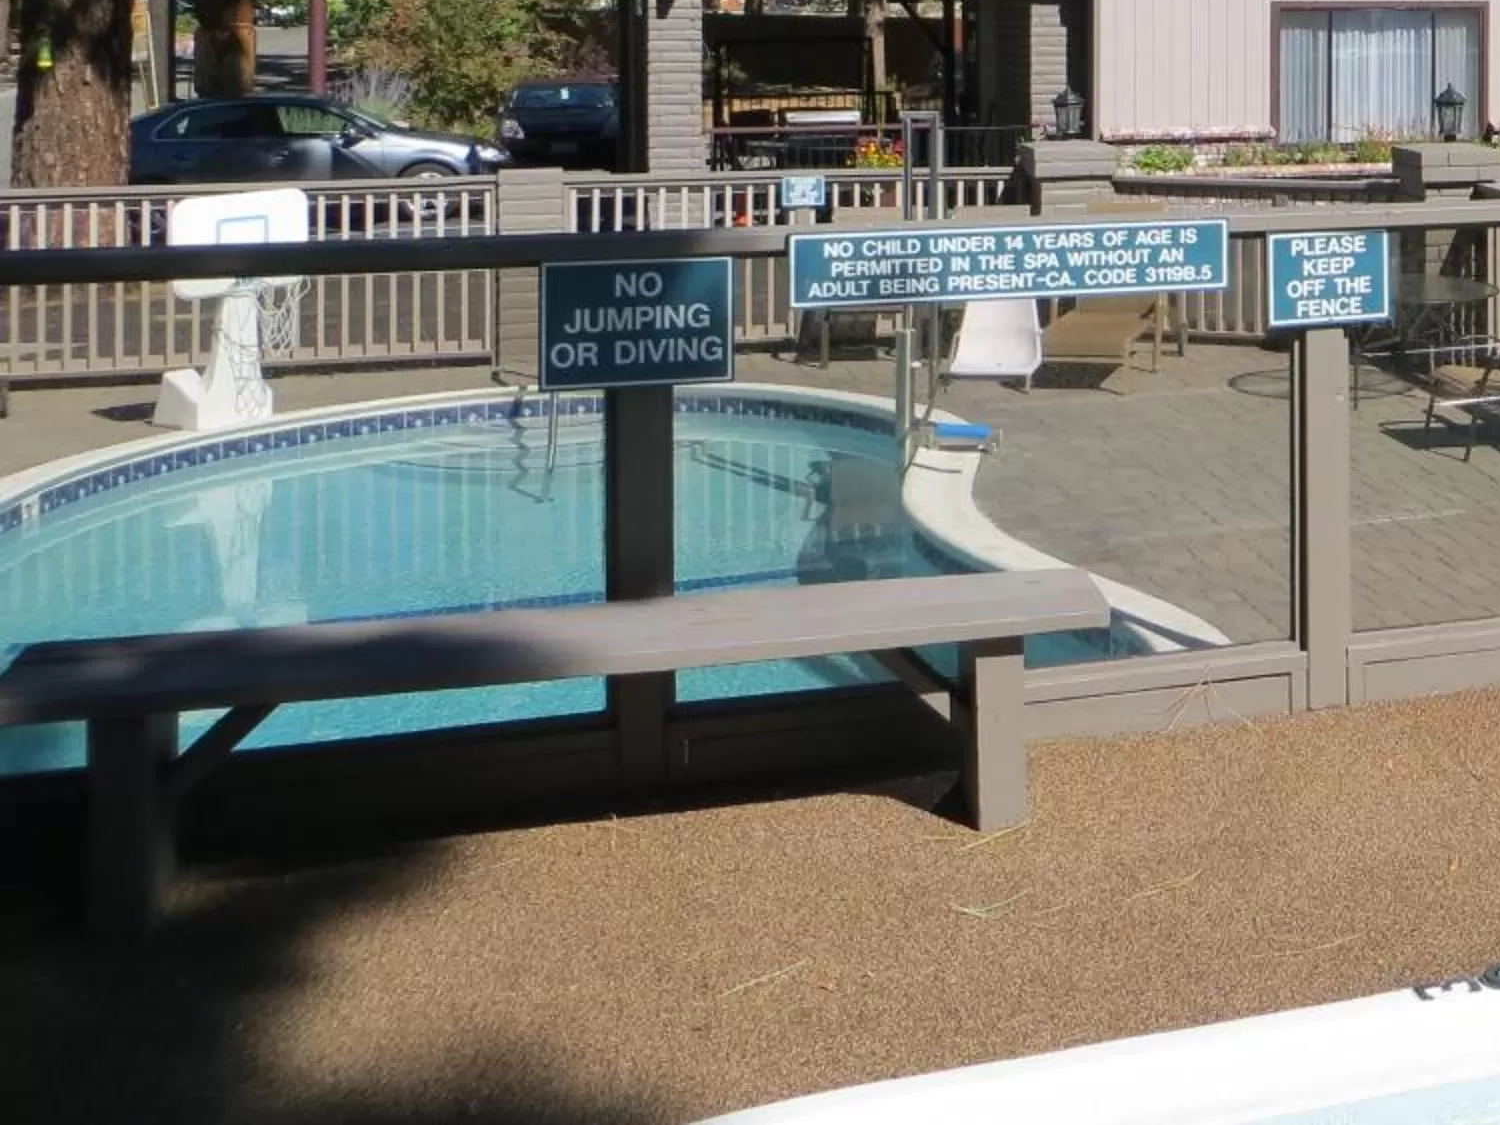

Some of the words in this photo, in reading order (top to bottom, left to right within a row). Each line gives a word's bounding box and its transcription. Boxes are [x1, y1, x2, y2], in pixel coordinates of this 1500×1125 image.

[823, 240, 854, 258] NO
[862, 238, 921, 256] CHILD
[929, 235, 996, 254] UNDER
[1004, 235, 1024, 251] 14
[1033, 232, 1095, 249] YEARS
[1102, 230, 1128, 246] OF
[1135, 228, 1173, 245] AGE
[1180, 227, 1198, 244] IS
[1291, 235, 1367, 257] PLEASE
[831, 259, 943, 277] PERMITTED
[951, 255, 971, 272] IN
[977, 254, 1015, 270] THE
[1023, 253, 1059, 269] SPA
[1067, 249, 1151, 267] WITHOUT
[1158, 248, 1184, 263] AN
[1303, 257, 1355, 276] KEEP
[615, 272, 663, 298] NO
[808, 281, 870, 298] ADULT
[879, 278, 940, 295] BEING
[1085, 268, 1137, 284] CODE
[1287, 279, 1326, 298] OFF
[1334, 276, 1372, 294] THE
[564, 303, 711, 334] JUMPING
[1297, 296, 1362, 317] FENCE
[551, 342, 599, 368] OR
[614, 336, 723, 365] DIVING
